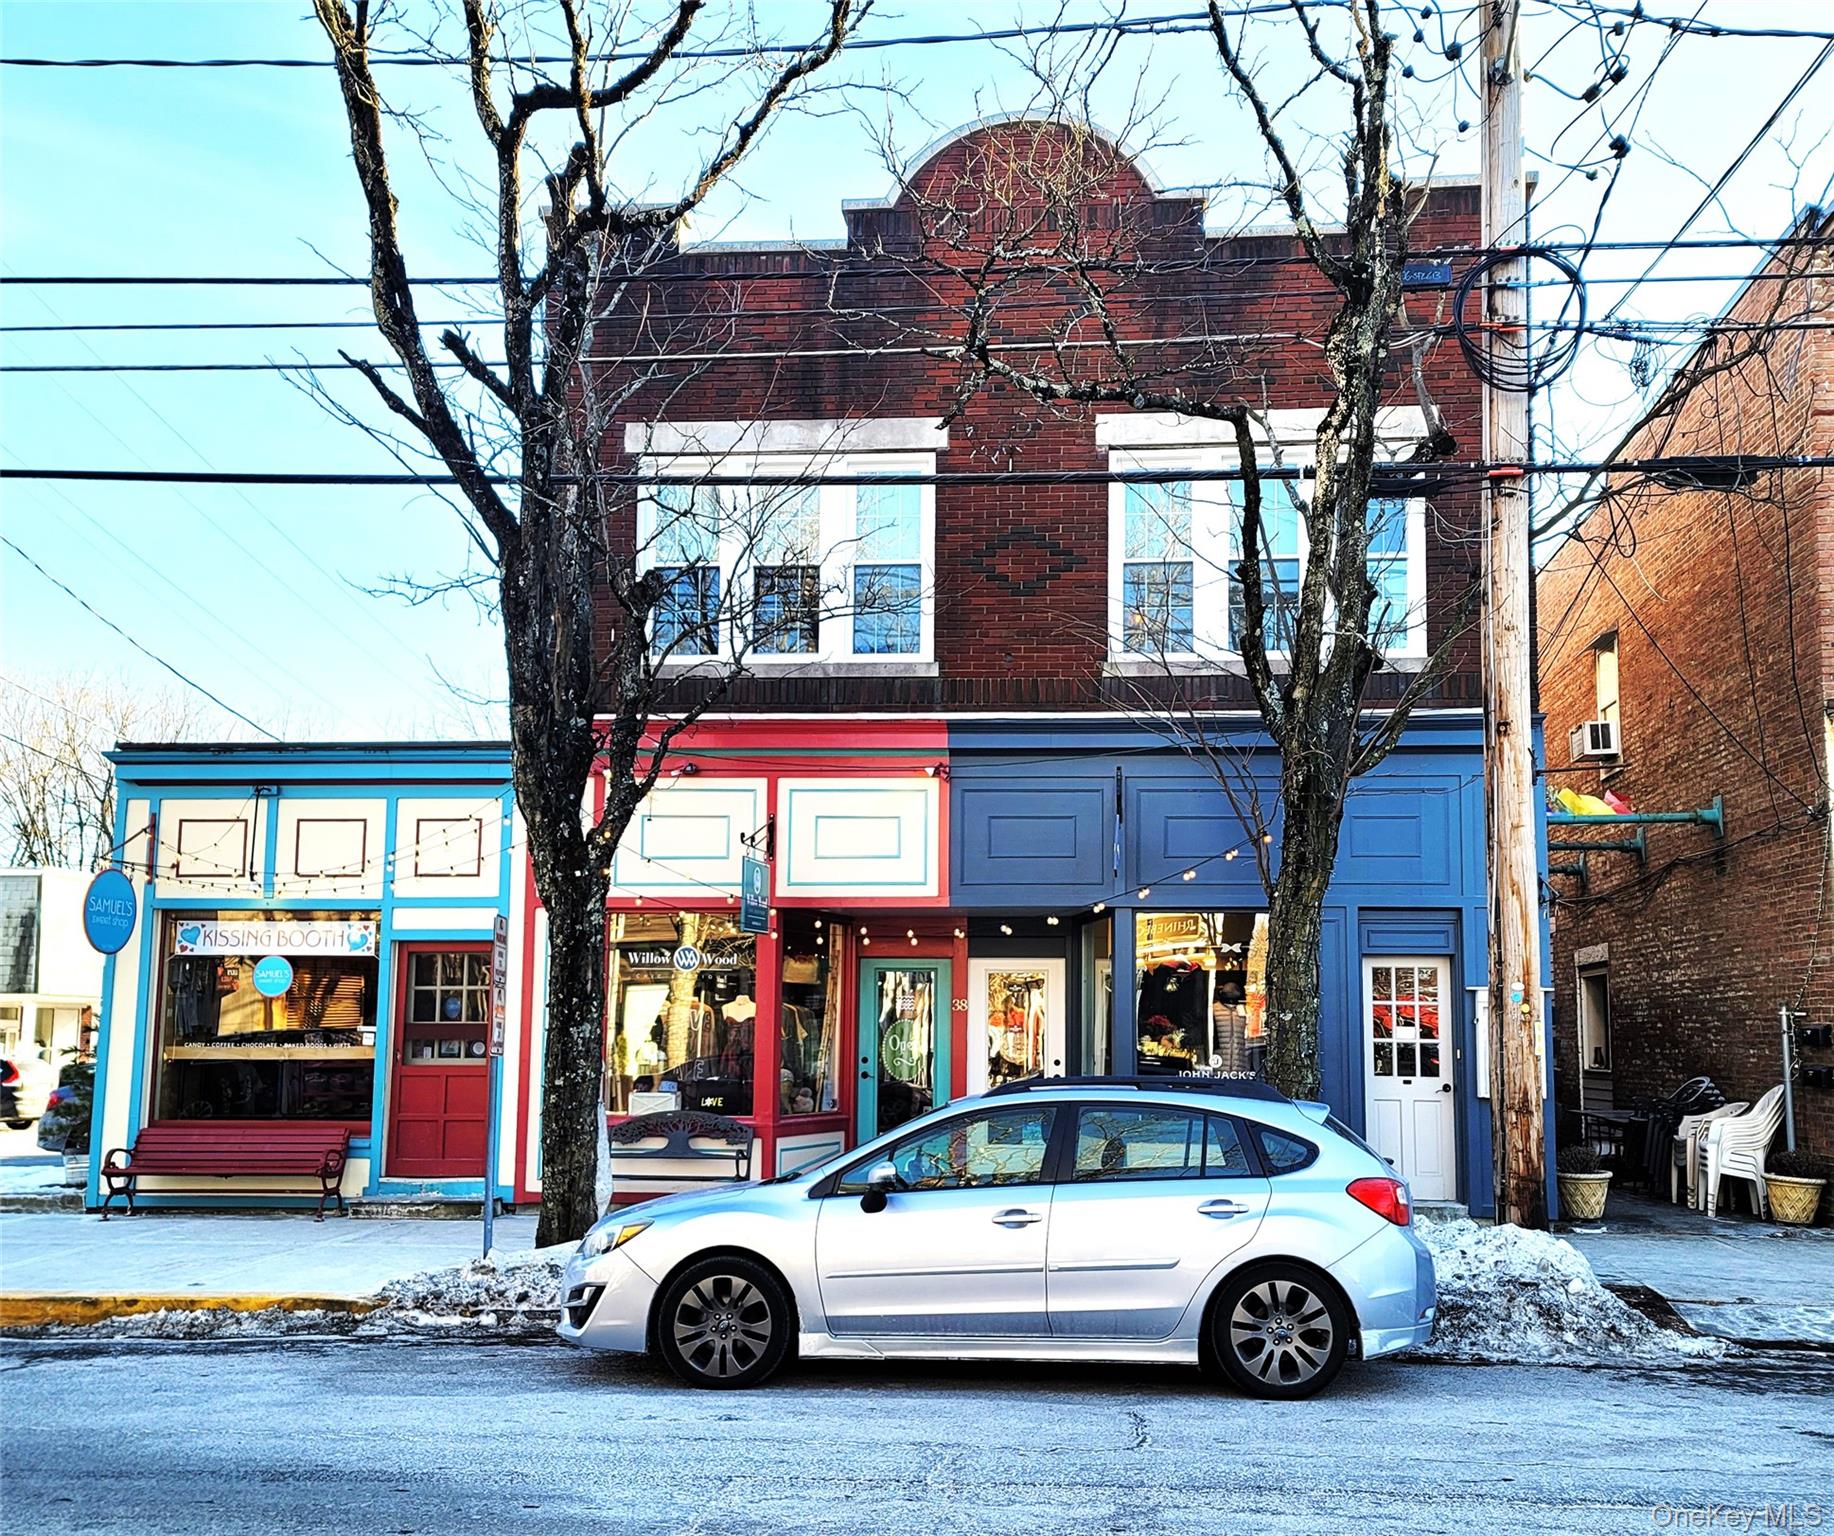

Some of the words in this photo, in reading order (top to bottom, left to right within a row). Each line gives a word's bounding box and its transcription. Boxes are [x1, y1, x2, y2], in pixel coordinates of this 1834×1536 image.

[89, 896, 133, 917] SAMUEL'S
[203, 930, 272, 948] KISSING
[277, 930, 345, 948] BOOTH
[628, 951, 672, 964] Willow
[702, 952, 738, 965] Wood
[952, 998, 968, 1011] 38
[889, 1034, 916, 1055] Ope
[1178, 1070, 1210, 1079] JOHN
[1214, 1071, 1257, 1080] JACK'S
